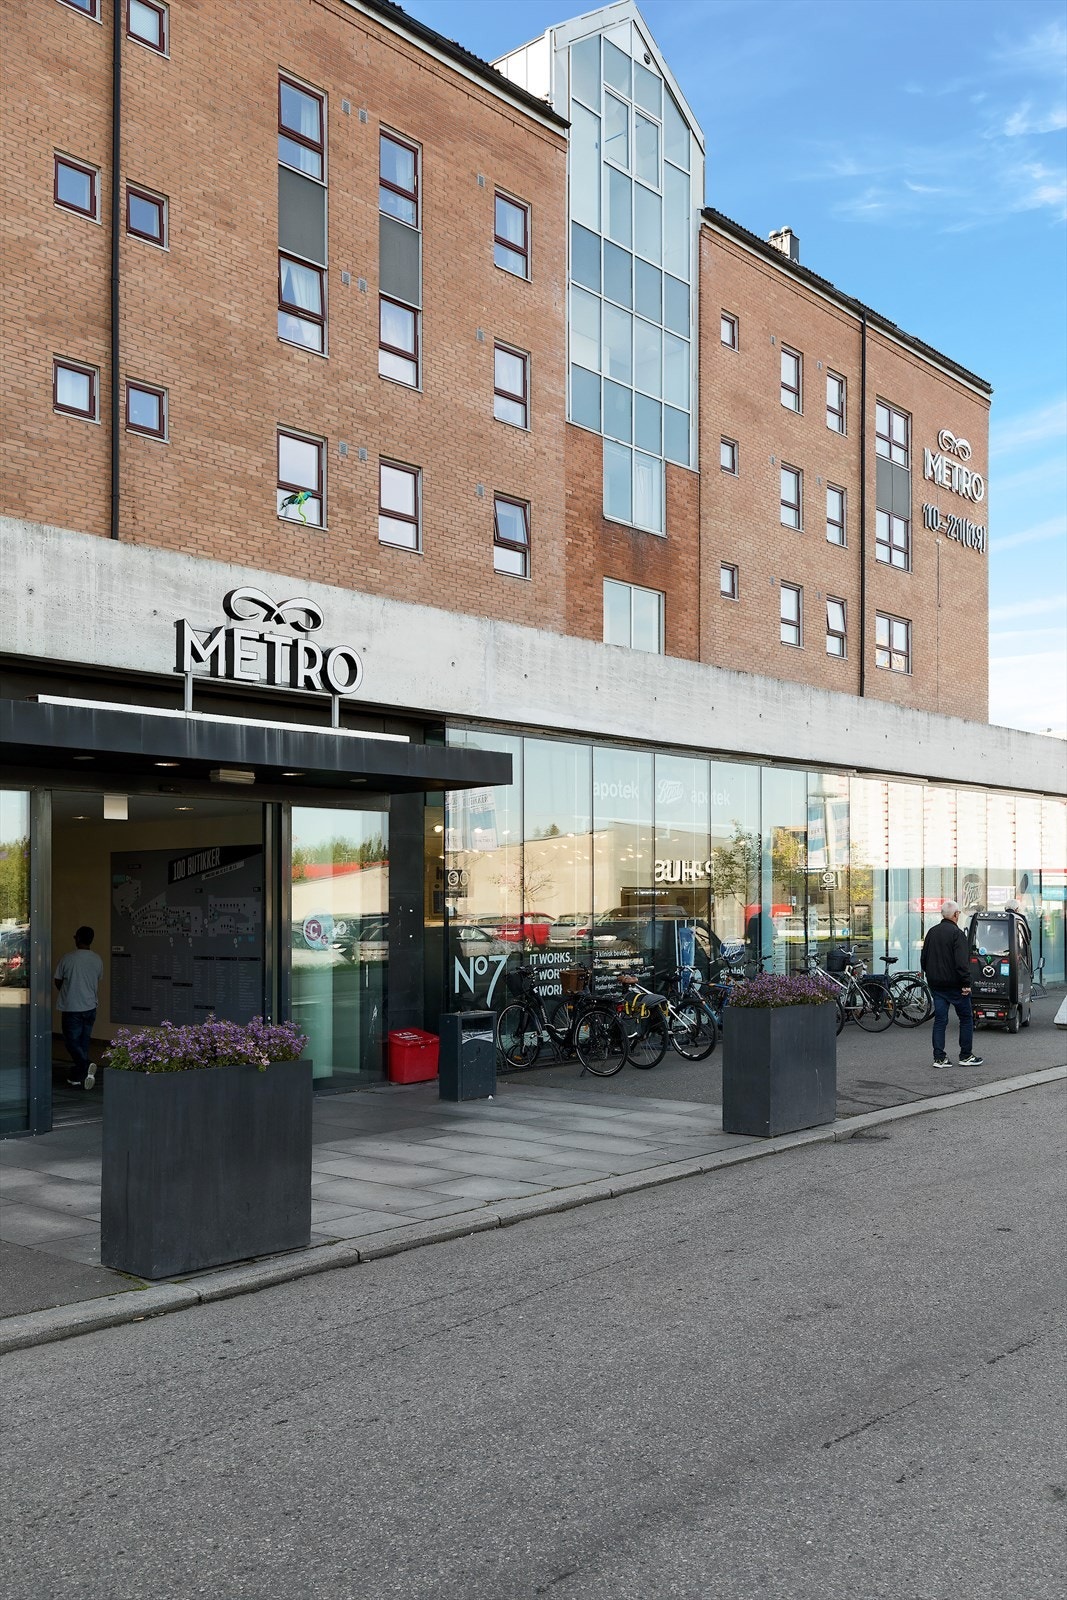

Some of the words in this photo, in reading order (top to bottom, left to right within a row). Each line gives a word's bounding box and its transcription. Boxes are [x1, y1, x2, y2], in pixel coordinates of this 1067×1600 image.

[923, 447, 985, 504] METRO
[174, 618, 364, 696] METRO
[593, 779, 639, 801] apotek
[172, 858, 186, 881] 100
[187, 846, 221, 876] BUTIKKER
[529, 953, 538, 965] IT
[538, 951, 573, 965] WORKS.
[538, 967, 570, 981] WOR
